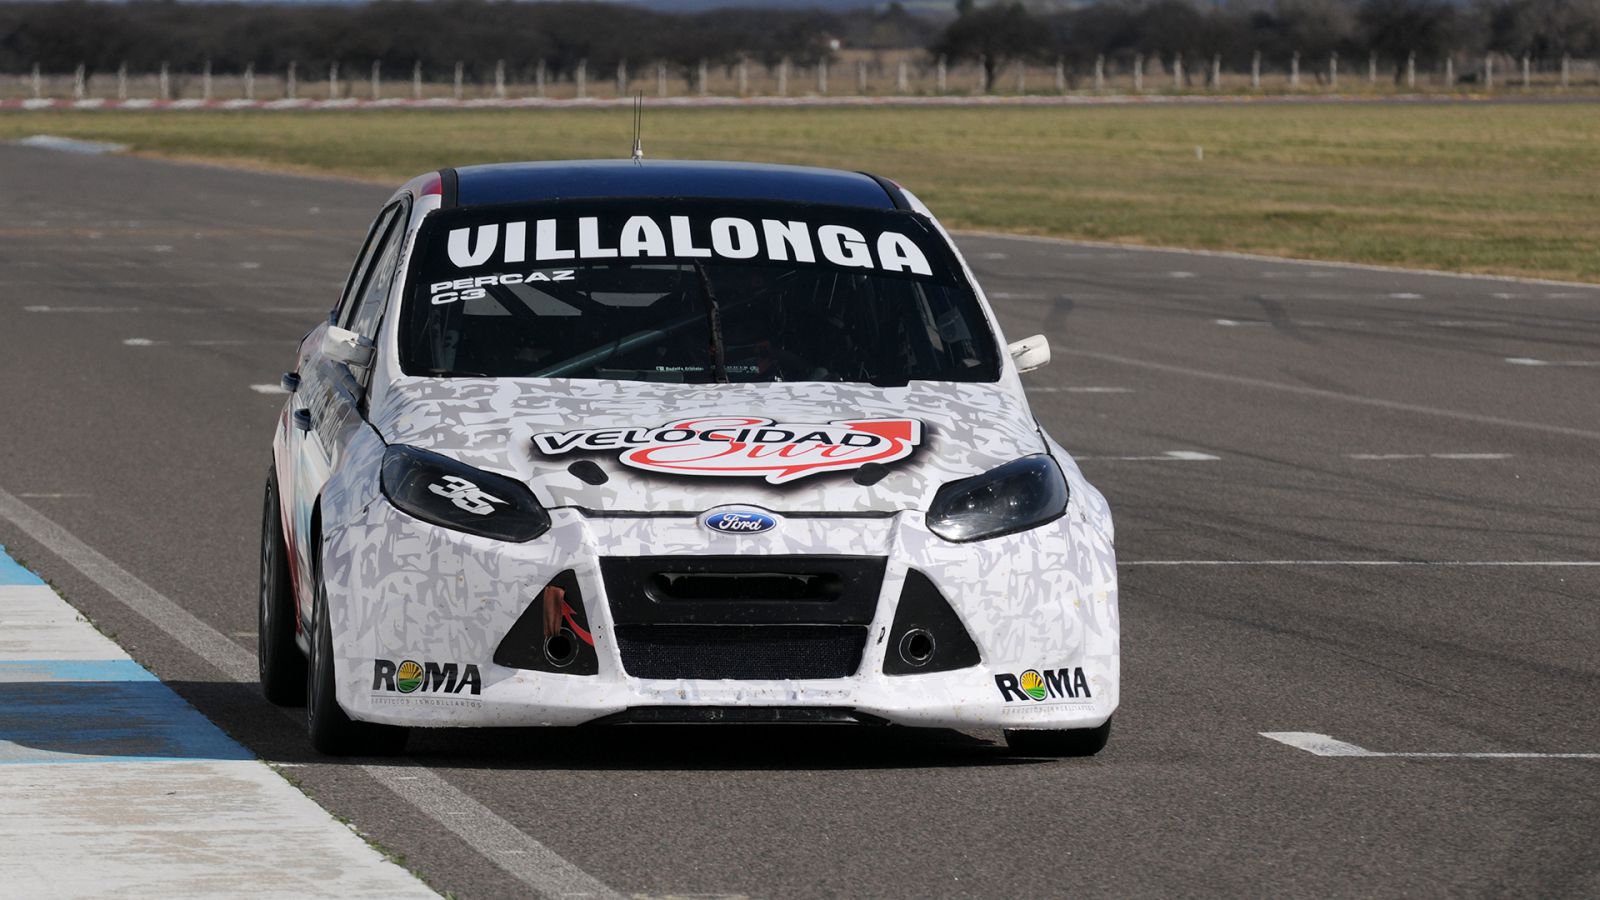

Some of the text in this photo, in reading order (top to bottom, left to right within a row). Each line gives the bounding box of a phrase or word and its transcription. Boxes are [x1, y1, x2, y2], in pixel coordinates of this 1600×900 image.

[447, 215, 933, 276] VILLALONGA
[430, 269, 576, 294] PERCAZ
[431, 288, 487, 305] C3
[542, 428, 882, 451] VELOCIDAD
[428, 475, 511, 515] 35
[719, 513, 762, 530] Ford
[372, 659, 482, 695] ROMA
[994, 667, 1091, 702] ROMA
